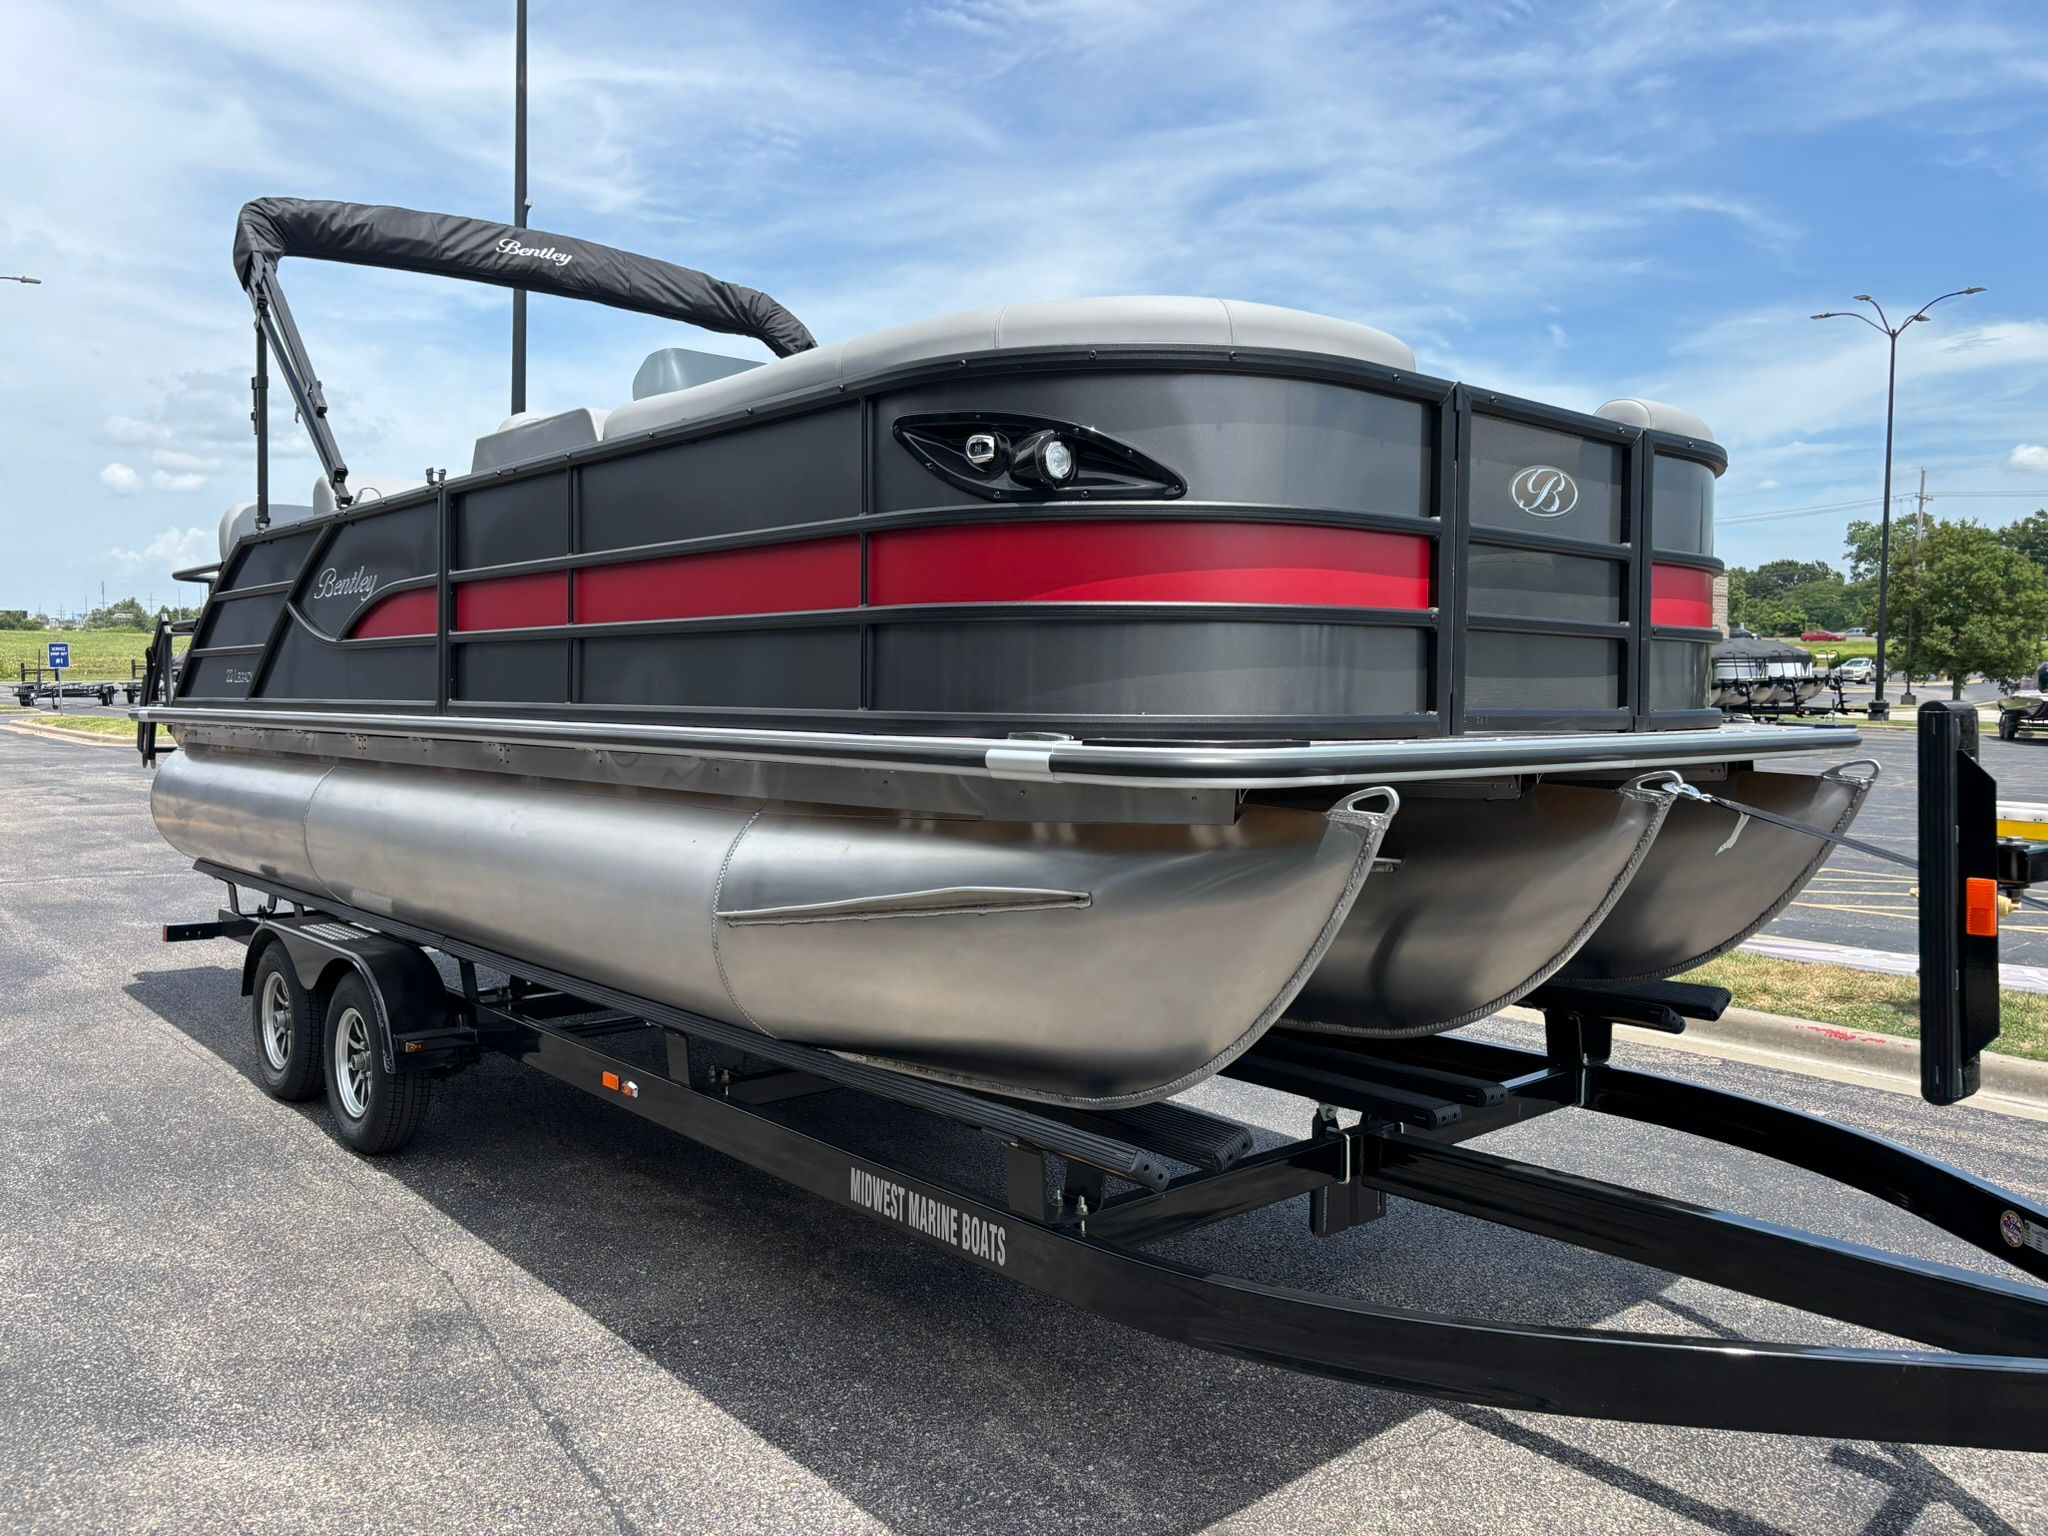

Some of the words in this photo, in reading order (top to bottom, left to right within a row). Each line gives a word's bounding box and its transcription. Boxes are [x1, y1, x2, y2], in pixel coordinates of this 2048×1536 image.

[496, 238, 573, 266] Bentley
[1518, 467, 1566, 513] B
[313, 565, 378, 602] Bentley
[850, 1167, 905, 1222] MIDWEST
[908, 1191, 958, 1246] MARINE
[962, 1212, 1006, 1267] BOATS
